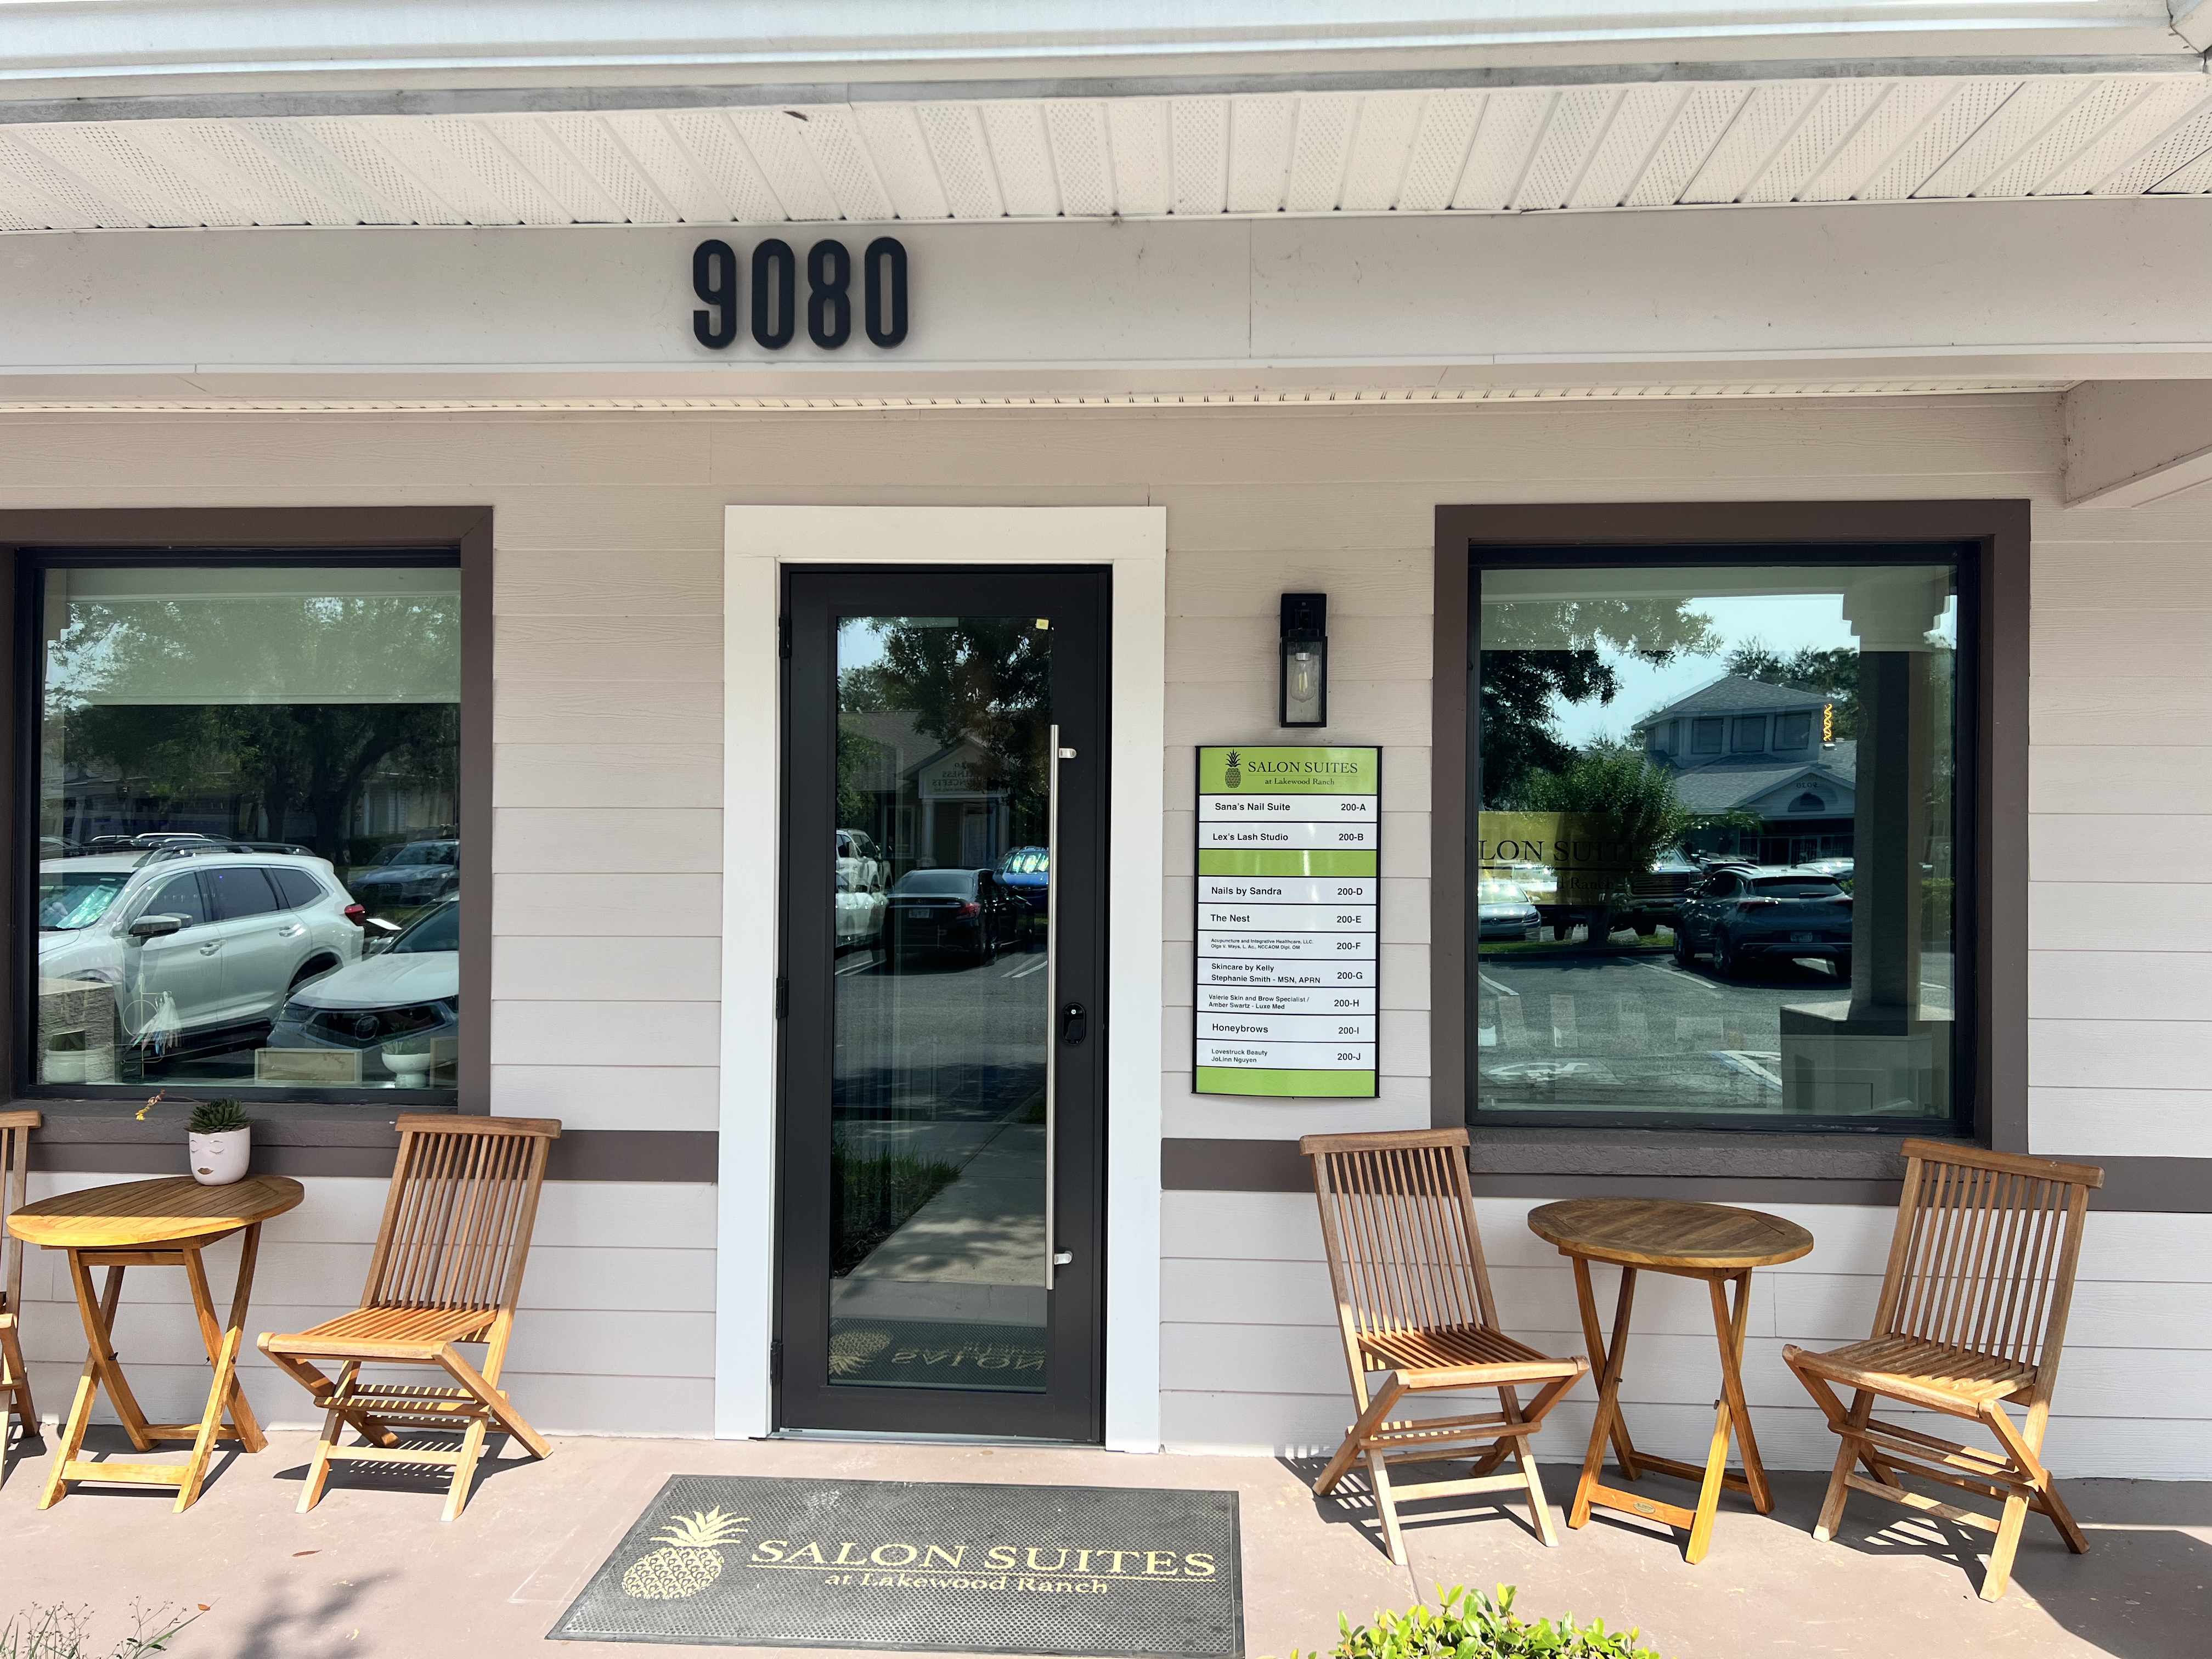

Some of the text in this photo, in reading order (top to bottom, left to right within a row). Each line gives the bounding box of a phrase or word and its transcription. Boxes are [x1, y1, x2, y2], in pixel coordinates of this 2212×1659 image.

[693, 236, 908, 350] 9080
[1248, 761, 1358, 774] SALON SUITES
[1215, 803, 1290, 811] Sana's Nail Suite
[1341, 803, 1366, 811] 200-A
[1260, 833, 1289, 841] Studio
[1339, 833, 1364, 841] 200-B
[1479, 840, 1542, 862] LON
[1211, 887, 1282, 896] Nails by Sandra
[1210, 914, 1250, 922] The Nest
[1336, 915, 1362, 923] 200-E
[1336, 942, 1361, 950] 200-F
[1245, 964, 1254, 972] by
[1256, 964, 1274, 973] Kelly
[1211, 974, 1248, 983] Stephanie
[1334, 999, 1359, 1007] 200-H
[1212, 1023, 1268, 1034] Honeybrows
[1338, 1026, 1359, 1035] 200-I
[1337, 1052, 1361, 1060] 200-J
[752, 1539, 1216, 1576] SALON SUITES
[825, 1573, 1108, 1593] at Lakewood Ranch
